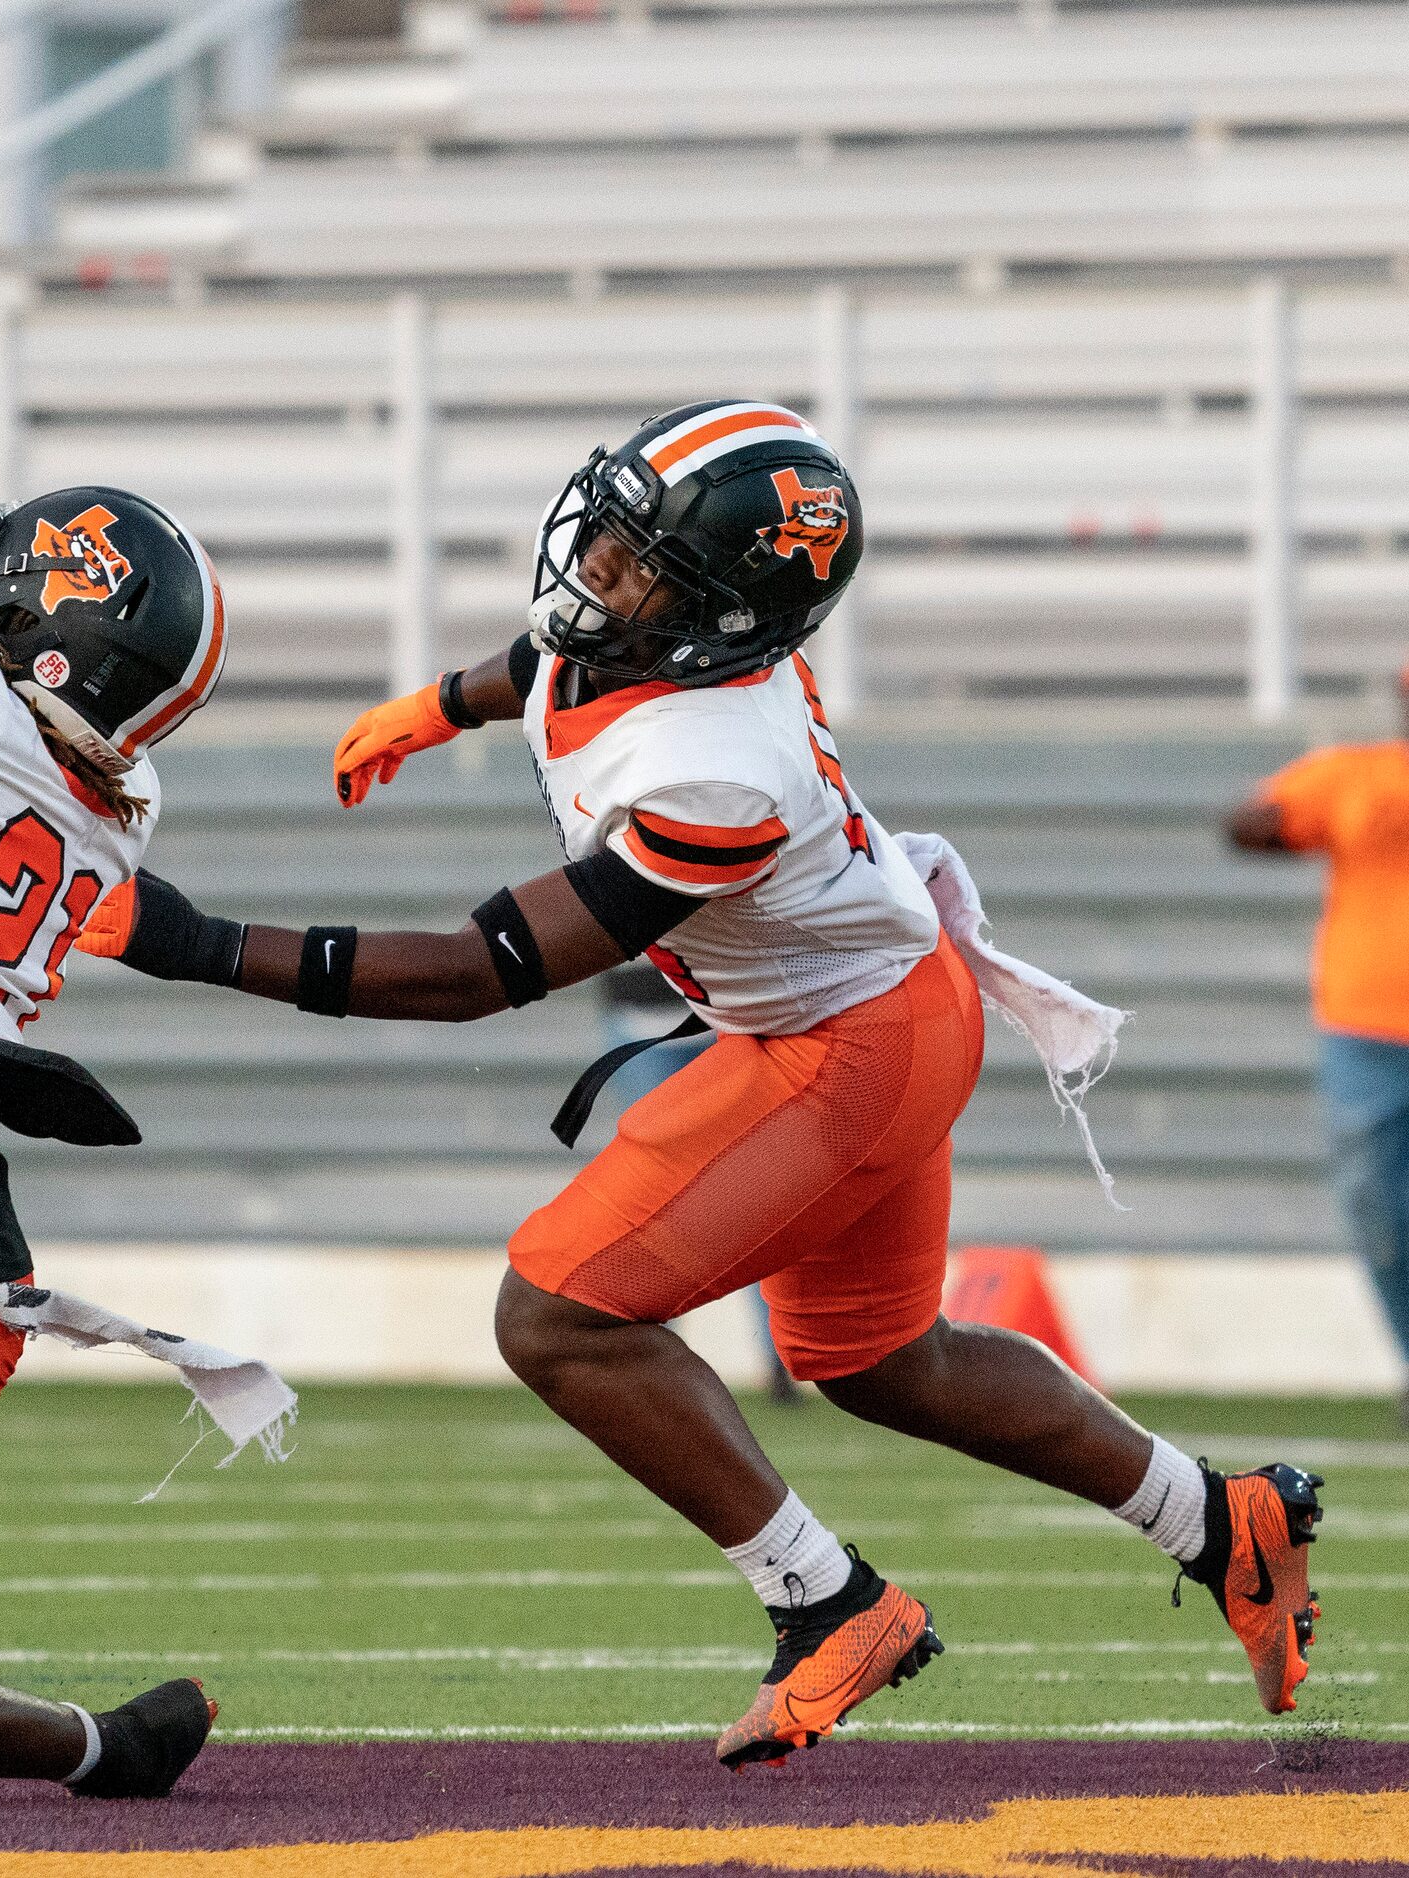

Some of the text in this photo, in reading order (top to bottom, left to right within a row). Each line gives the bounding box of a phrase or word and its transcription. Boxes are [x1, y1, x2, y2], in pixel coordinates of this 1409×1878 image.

[617, 473, 642, 500] schutt
[36, 660, 60, 686] EJ3
[46, 653, 67, 676] 66
[82, 680, 102, 697] LARGE
